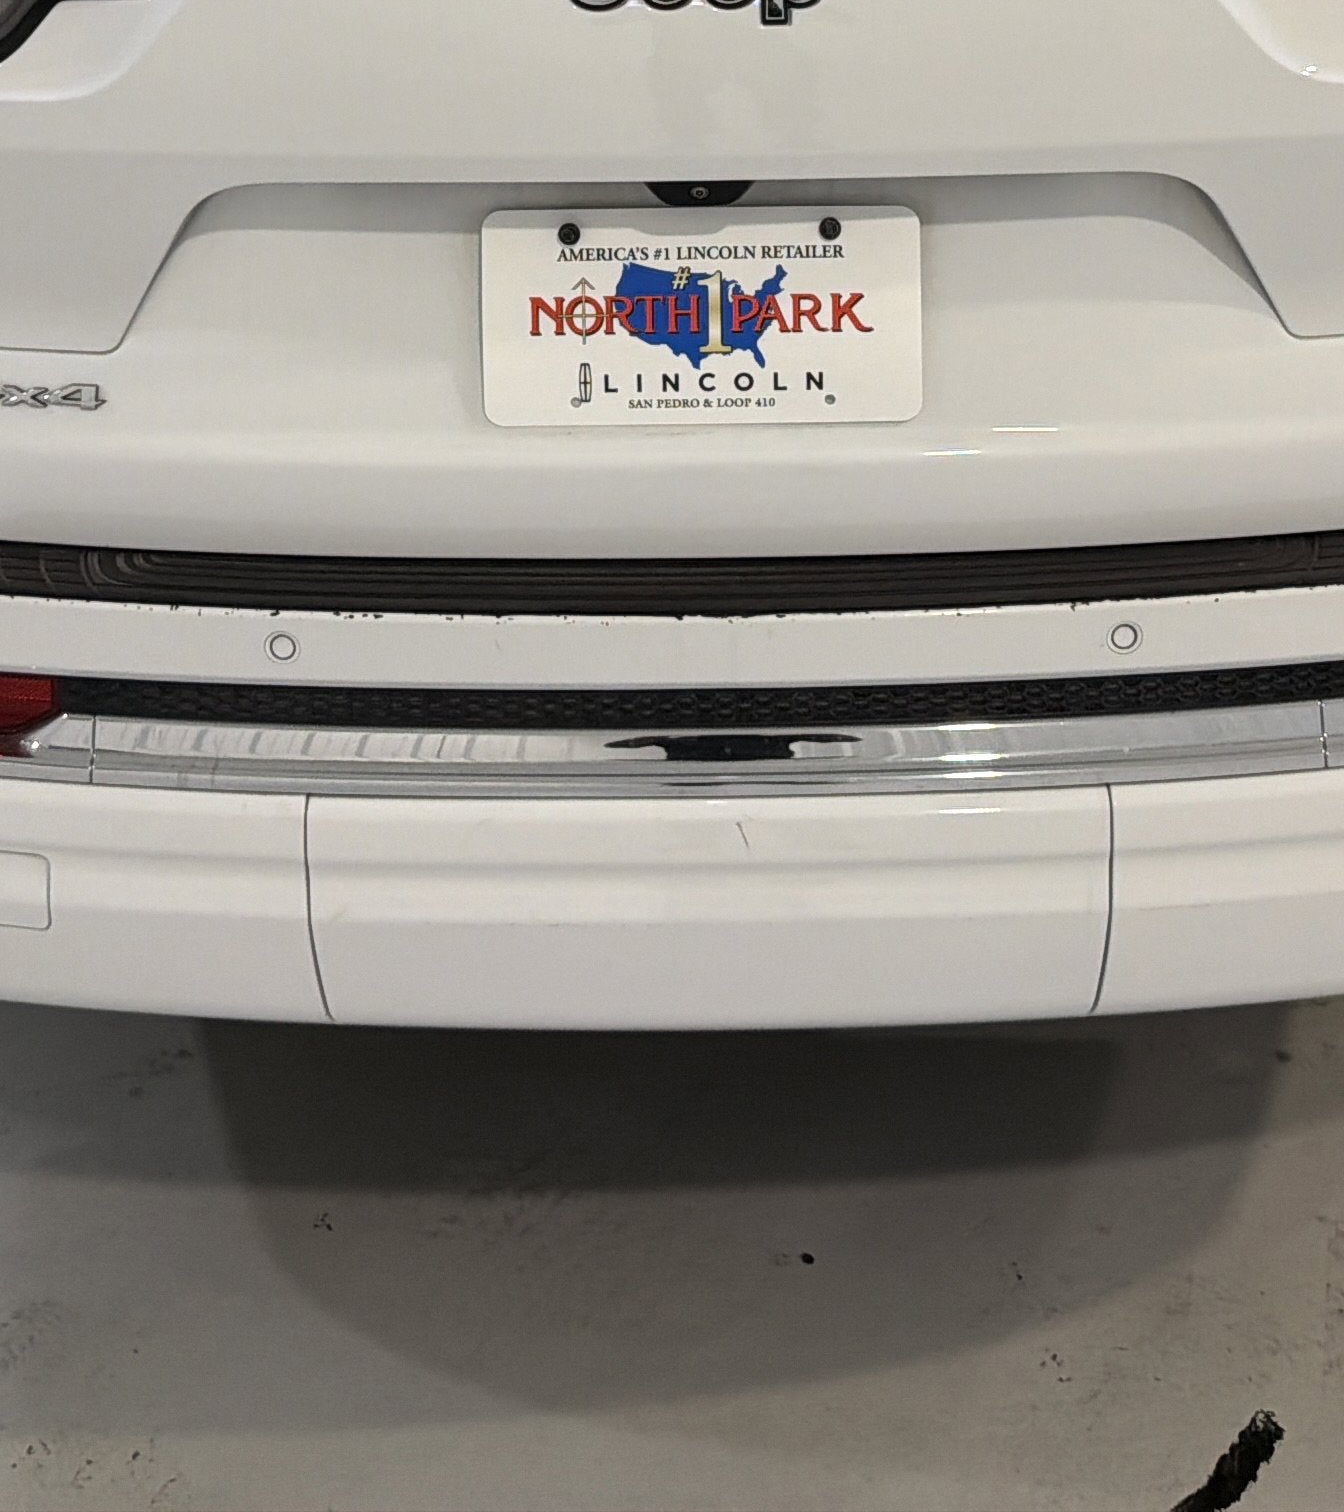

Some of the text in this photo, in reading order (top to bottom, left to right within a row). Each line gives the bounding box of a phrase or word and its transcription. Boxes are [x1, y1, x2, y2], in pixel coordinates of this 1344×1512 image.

[557, 244, 845, 262] AMERICA'S #1 LINCOLN RETAILER
[528, 291, 875, 337] NORTH PARK
[603, 371, 825, 393] LINCOLN
[627, 397, 776, 410] SAN PEDRO & LOOP 410
